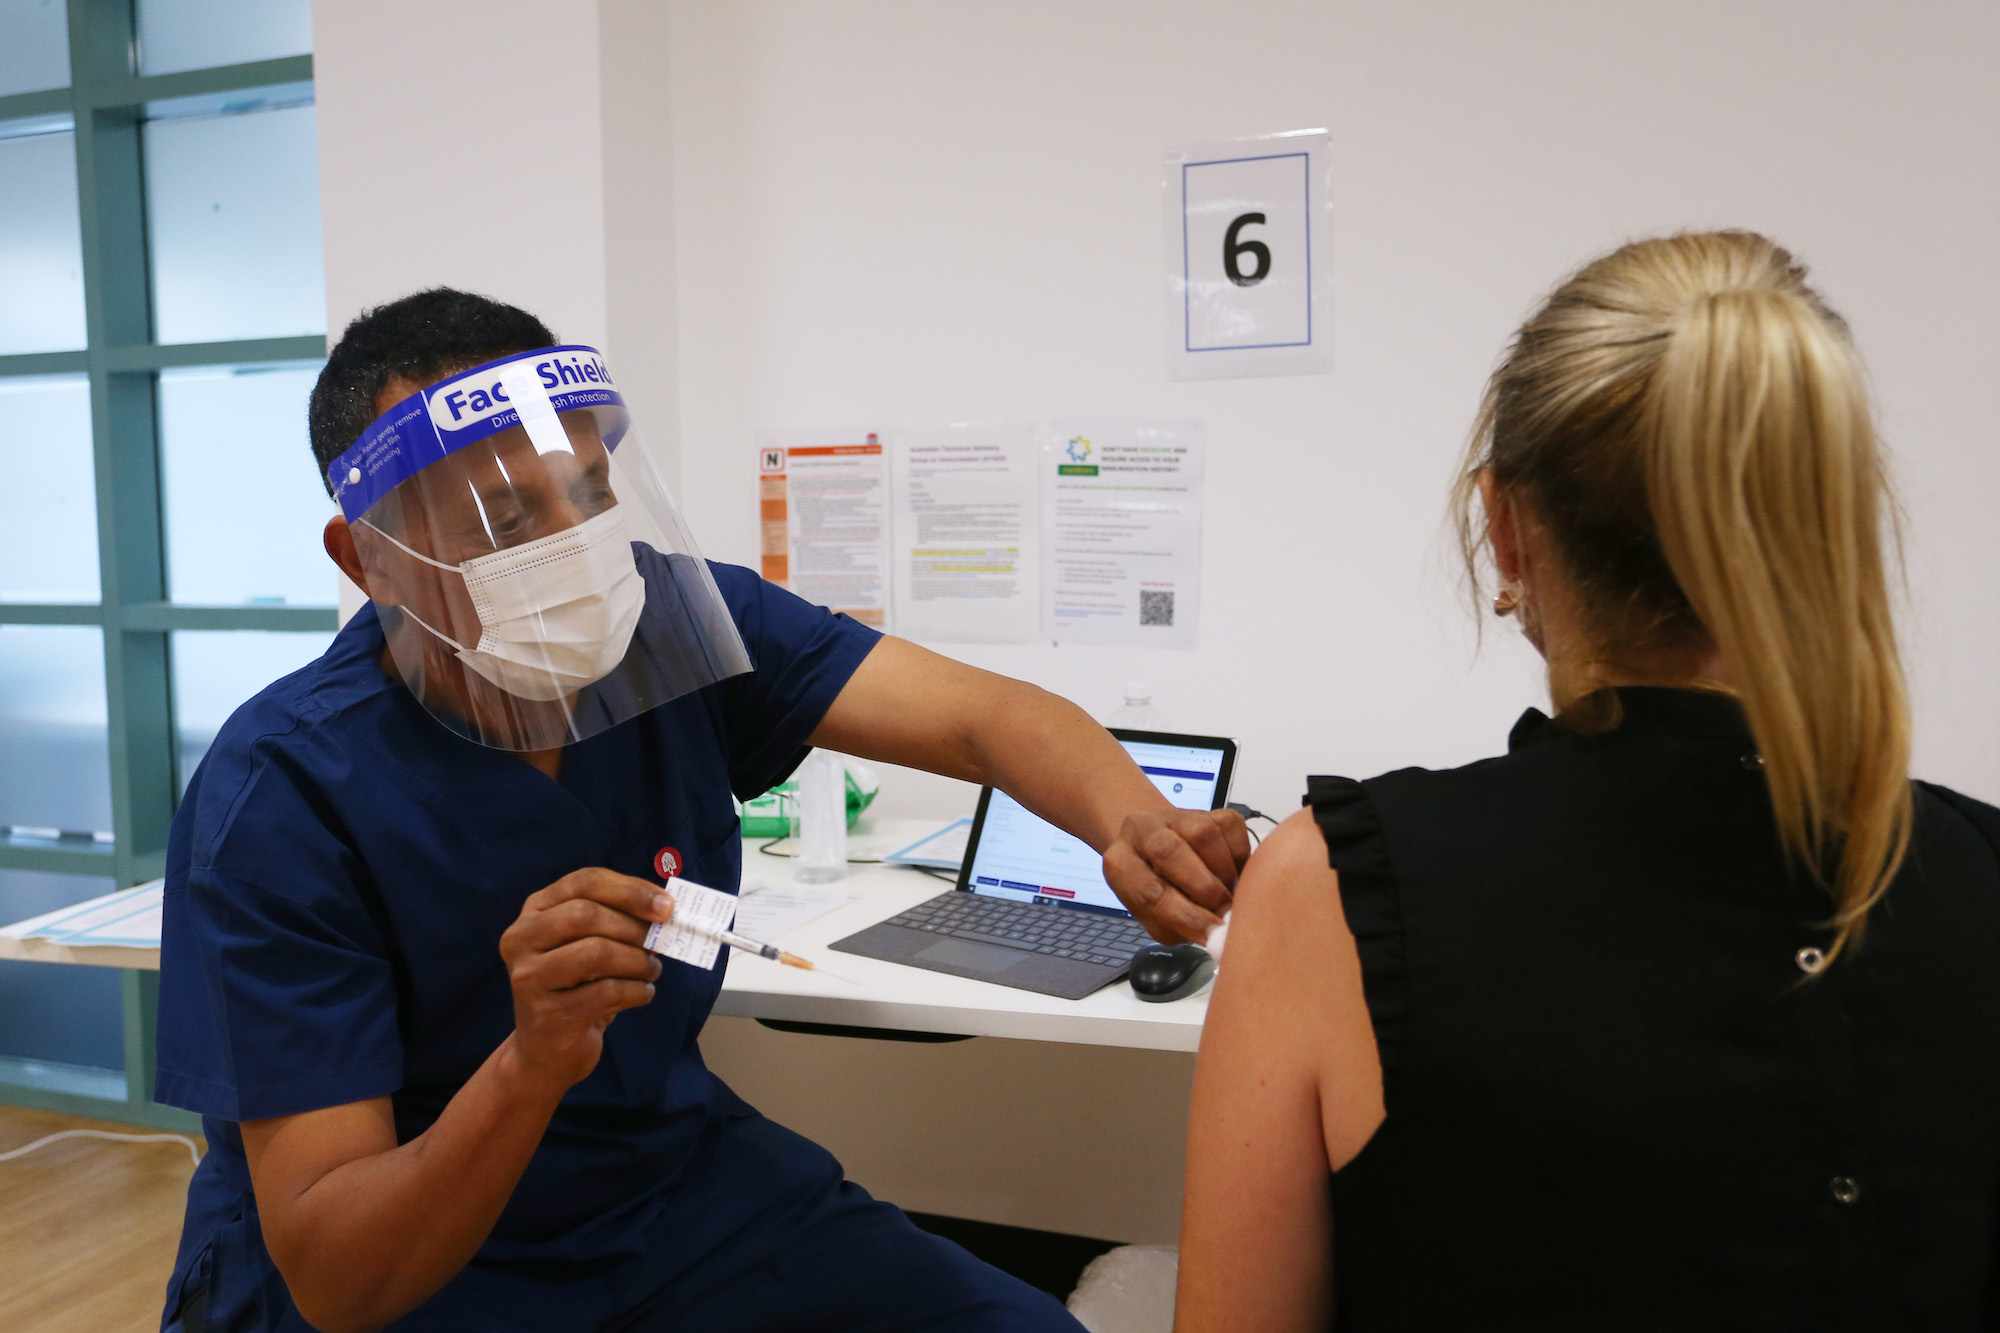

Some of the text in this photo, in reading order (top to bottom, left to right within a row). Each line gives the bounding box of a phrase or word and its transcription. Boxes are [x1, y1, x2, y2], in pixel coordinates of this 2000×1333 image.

[1223, 212, 1272, 288] 6
[444, 356, 614, 422] Face Shield
[568, 391, 611, 406] Protection
[376, 424, 395, 444] gently
[394, 408, 423, 428] remove
[387, 433, 401, 447] film
[382, 447, 402, 463] using
[767, 453, 778, 466] N
